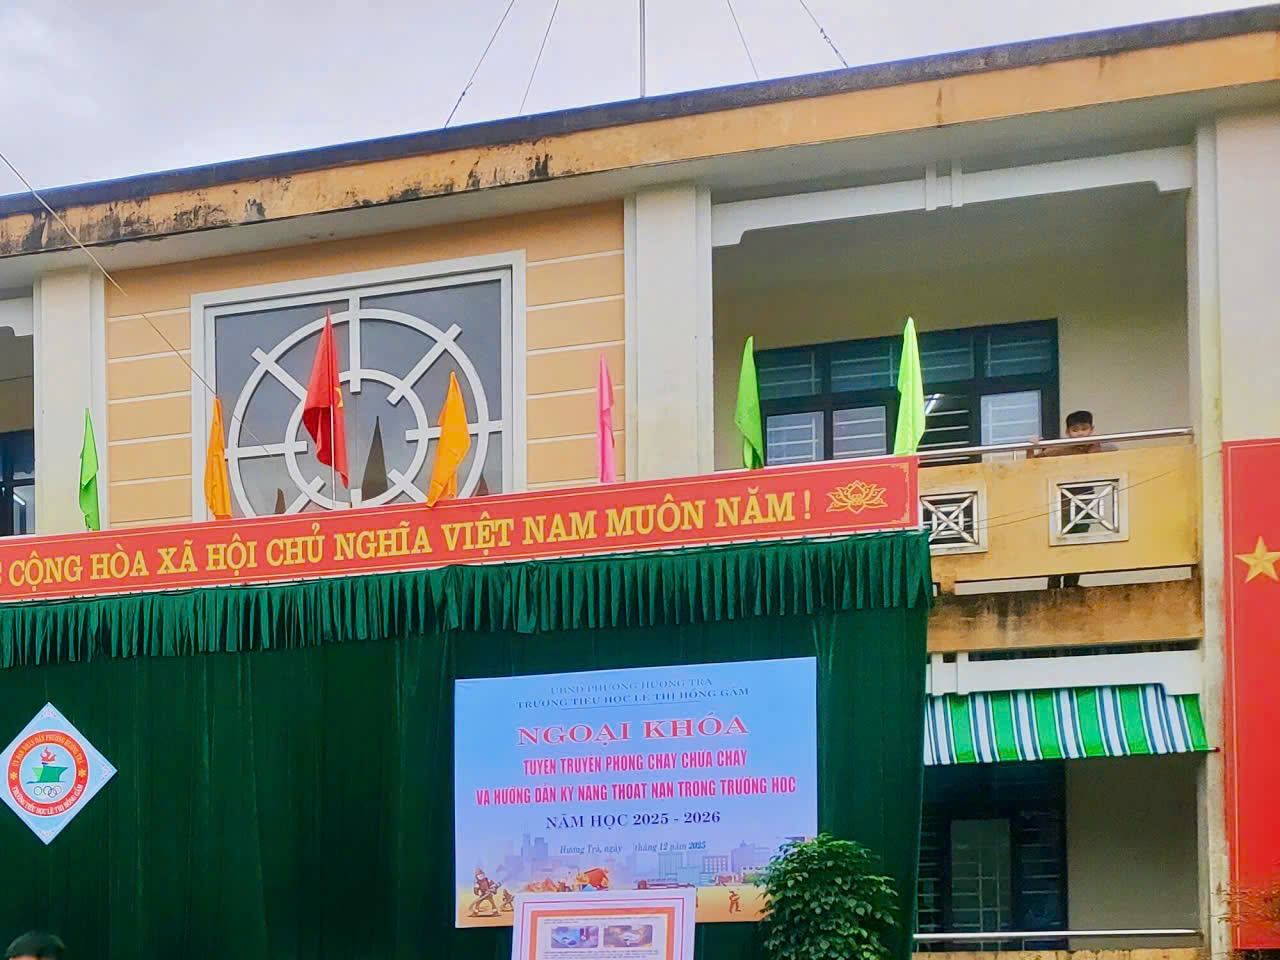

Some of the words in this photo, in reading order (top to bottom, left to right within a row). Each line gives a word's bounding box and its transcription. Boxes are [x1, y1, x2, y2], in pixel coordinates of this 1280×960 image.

[9, 551, 84, 592] CỘNG
[90, 543, 147, 583] HÒA
[157, 539, 198, 576] XÃ
[206, 532, 257, 575] HỘI
[265, 522, 325, 564] CHỦ
[334, 520, 433, 562] NGHĨA
[441, 511, 514, 556] VIỆT
[522, 511, 596, 545] NAM
[604, 492, 706, 538] MUÔN
[714, 485, 797, 529] NĂM
[803, 490, 812, 521] !
[517, 721, 633, 747] NGOẠI
[643, 711, 750, 740] KHÓA
[678, 779, 716, 797] TRONG
[591, 814, 629, 830] HỌC
[632, 812, 669, 826] 2025
[683, 811, 721, 824] 2026
